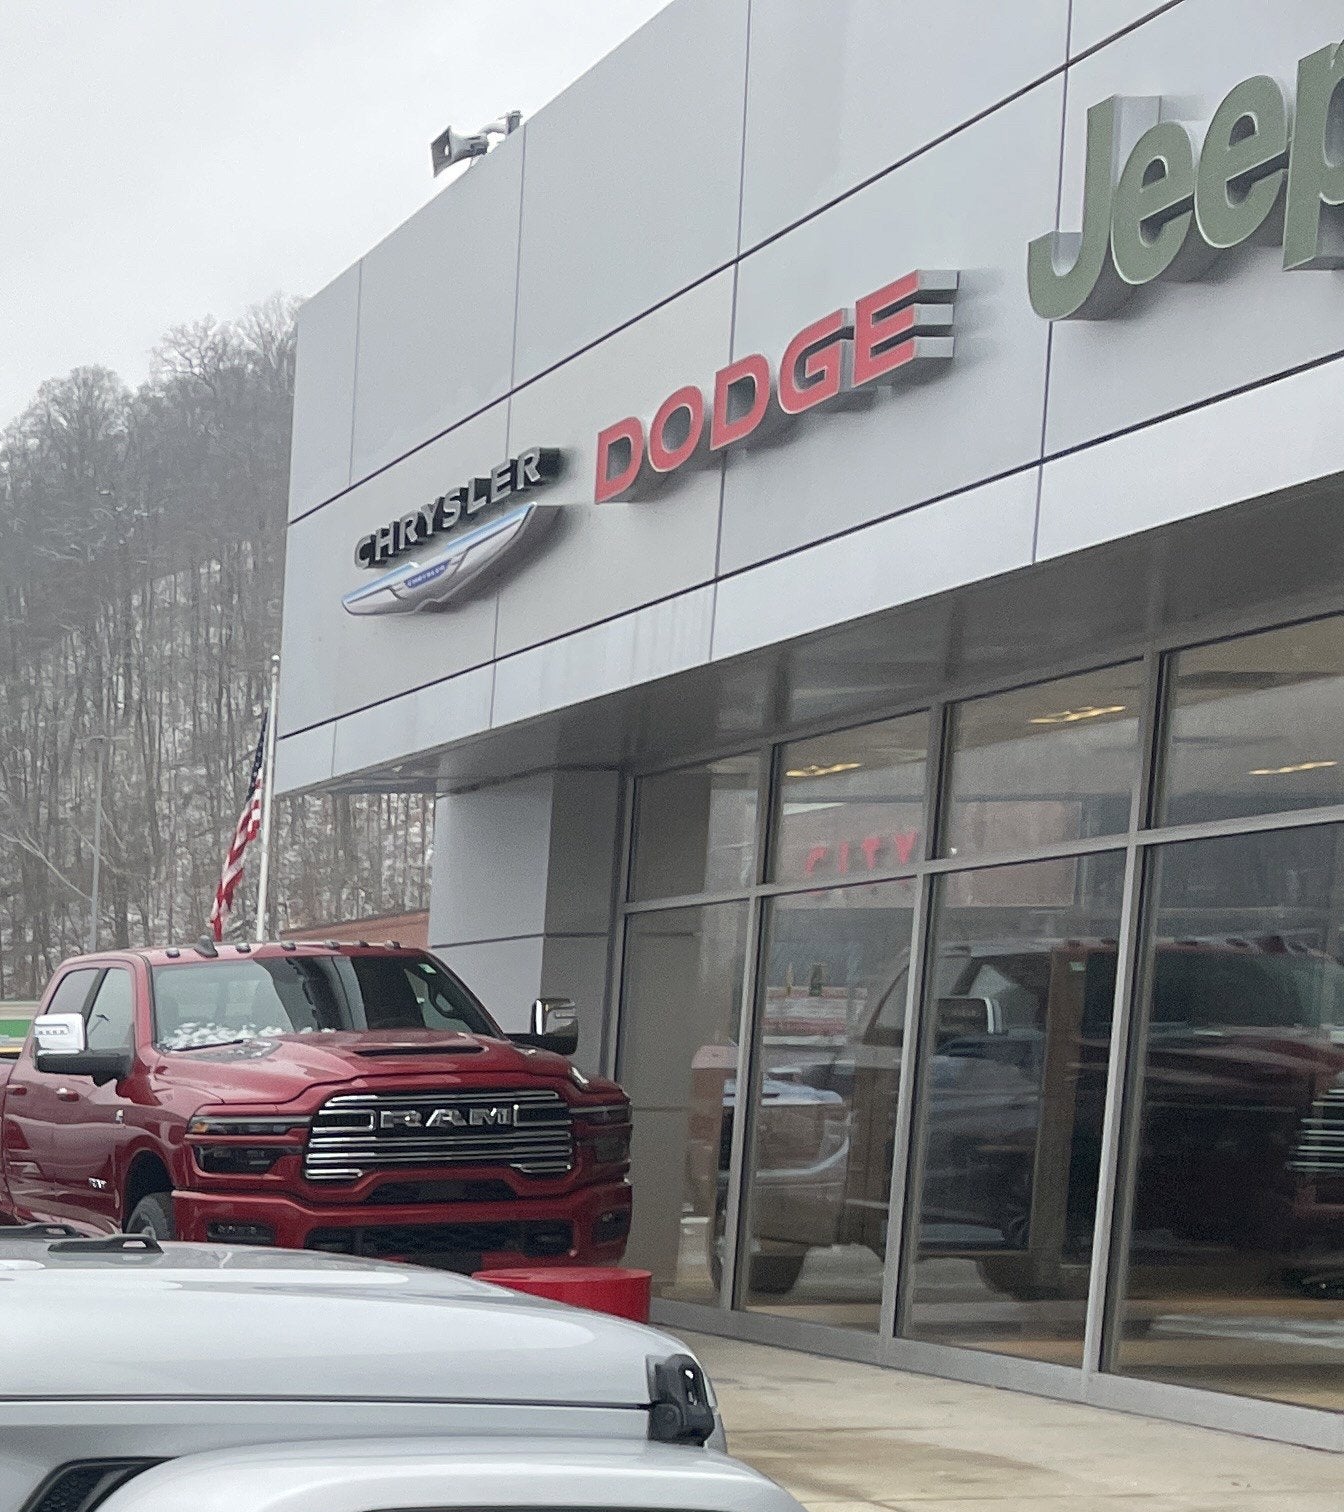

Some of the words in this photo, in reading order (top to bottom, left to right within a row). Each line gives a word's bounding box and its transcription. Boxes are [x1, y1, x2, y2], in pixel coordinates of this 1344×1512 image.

[1026, 39, 1344, 322] Jeep
[594, 268, 924, 505] DODGE
[354, 446, 544, 569] CHRYSLER
[379, 1106, 513, 1130] RAM
